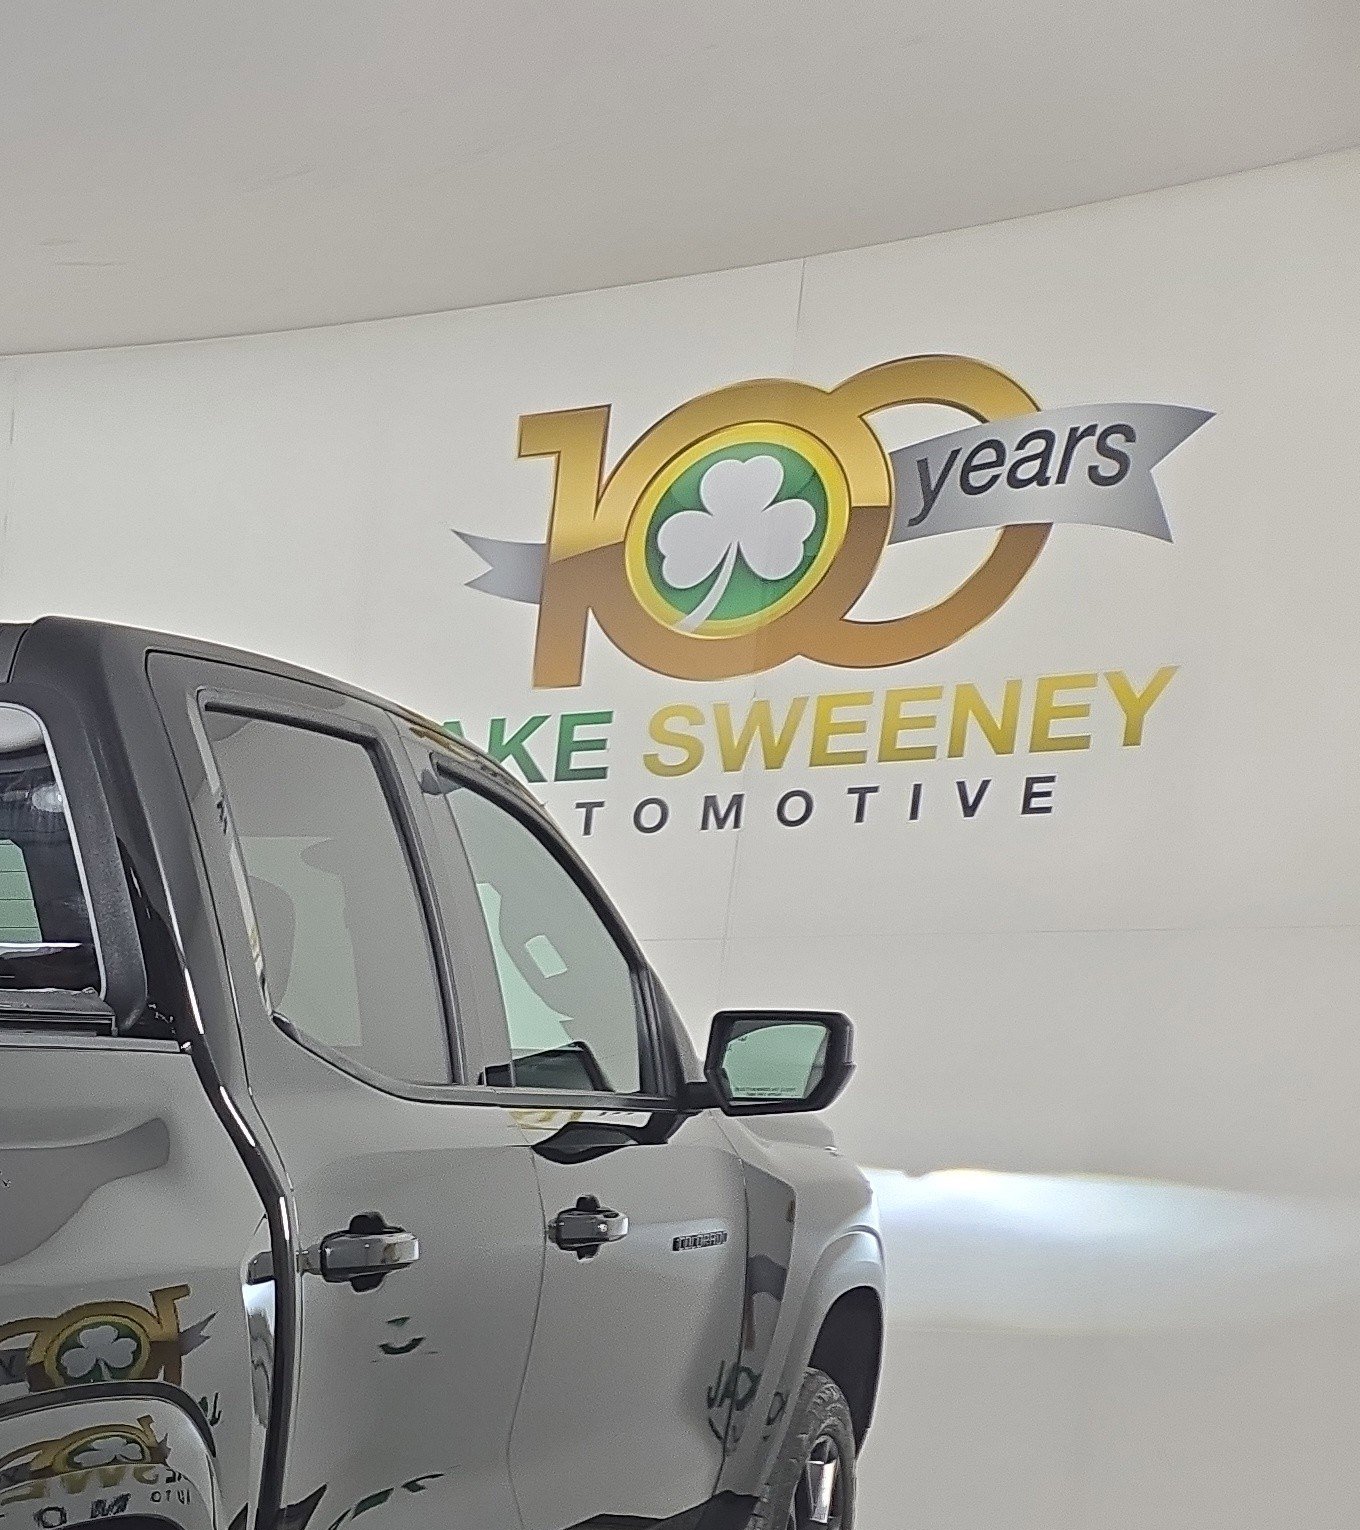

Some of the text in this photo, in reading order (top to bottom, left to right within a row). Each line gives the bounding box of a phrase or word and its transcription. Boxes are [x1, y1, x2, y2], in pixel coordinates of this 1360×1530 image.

[907, 422, 1137, 527] years
[642, 664, 1179, 775] SWEENEY
[574, 774, 1056, 838] TOMOTIVE
